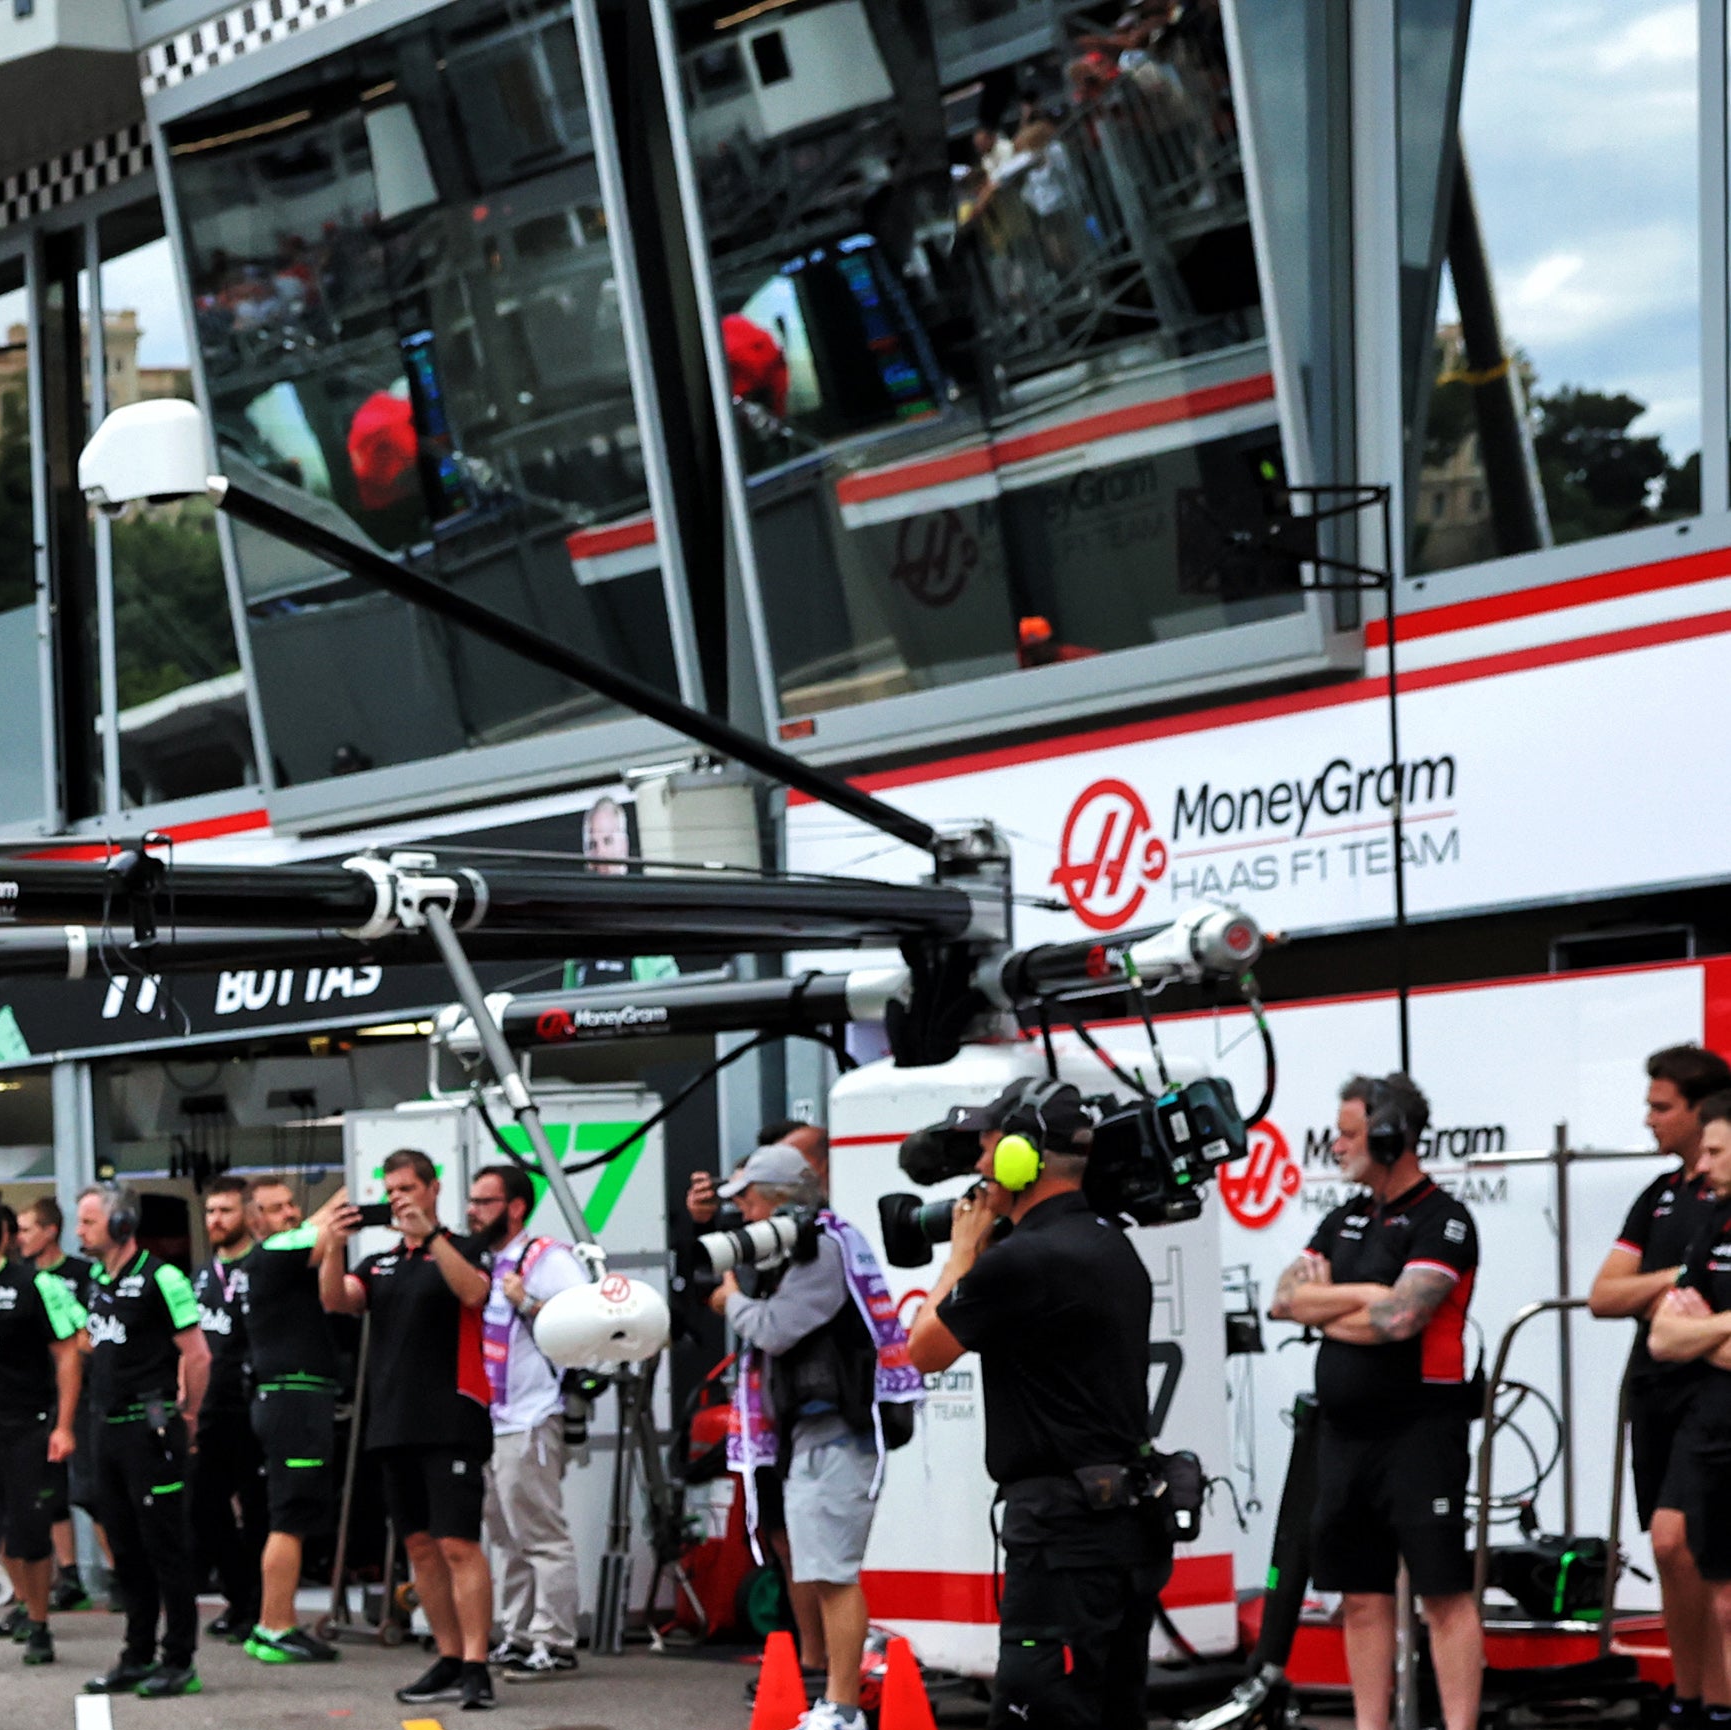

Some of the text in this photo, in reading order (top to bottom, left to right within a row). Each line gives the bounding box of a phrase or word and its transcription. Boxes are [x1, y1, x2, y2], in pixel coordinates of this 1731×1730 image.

[1172, 754, 1456, 841] MoneyGram
[1172, 829, 1461, 901] HAAS F1 TEAM
[574, 1005, 667, 1027] MoneyGram
